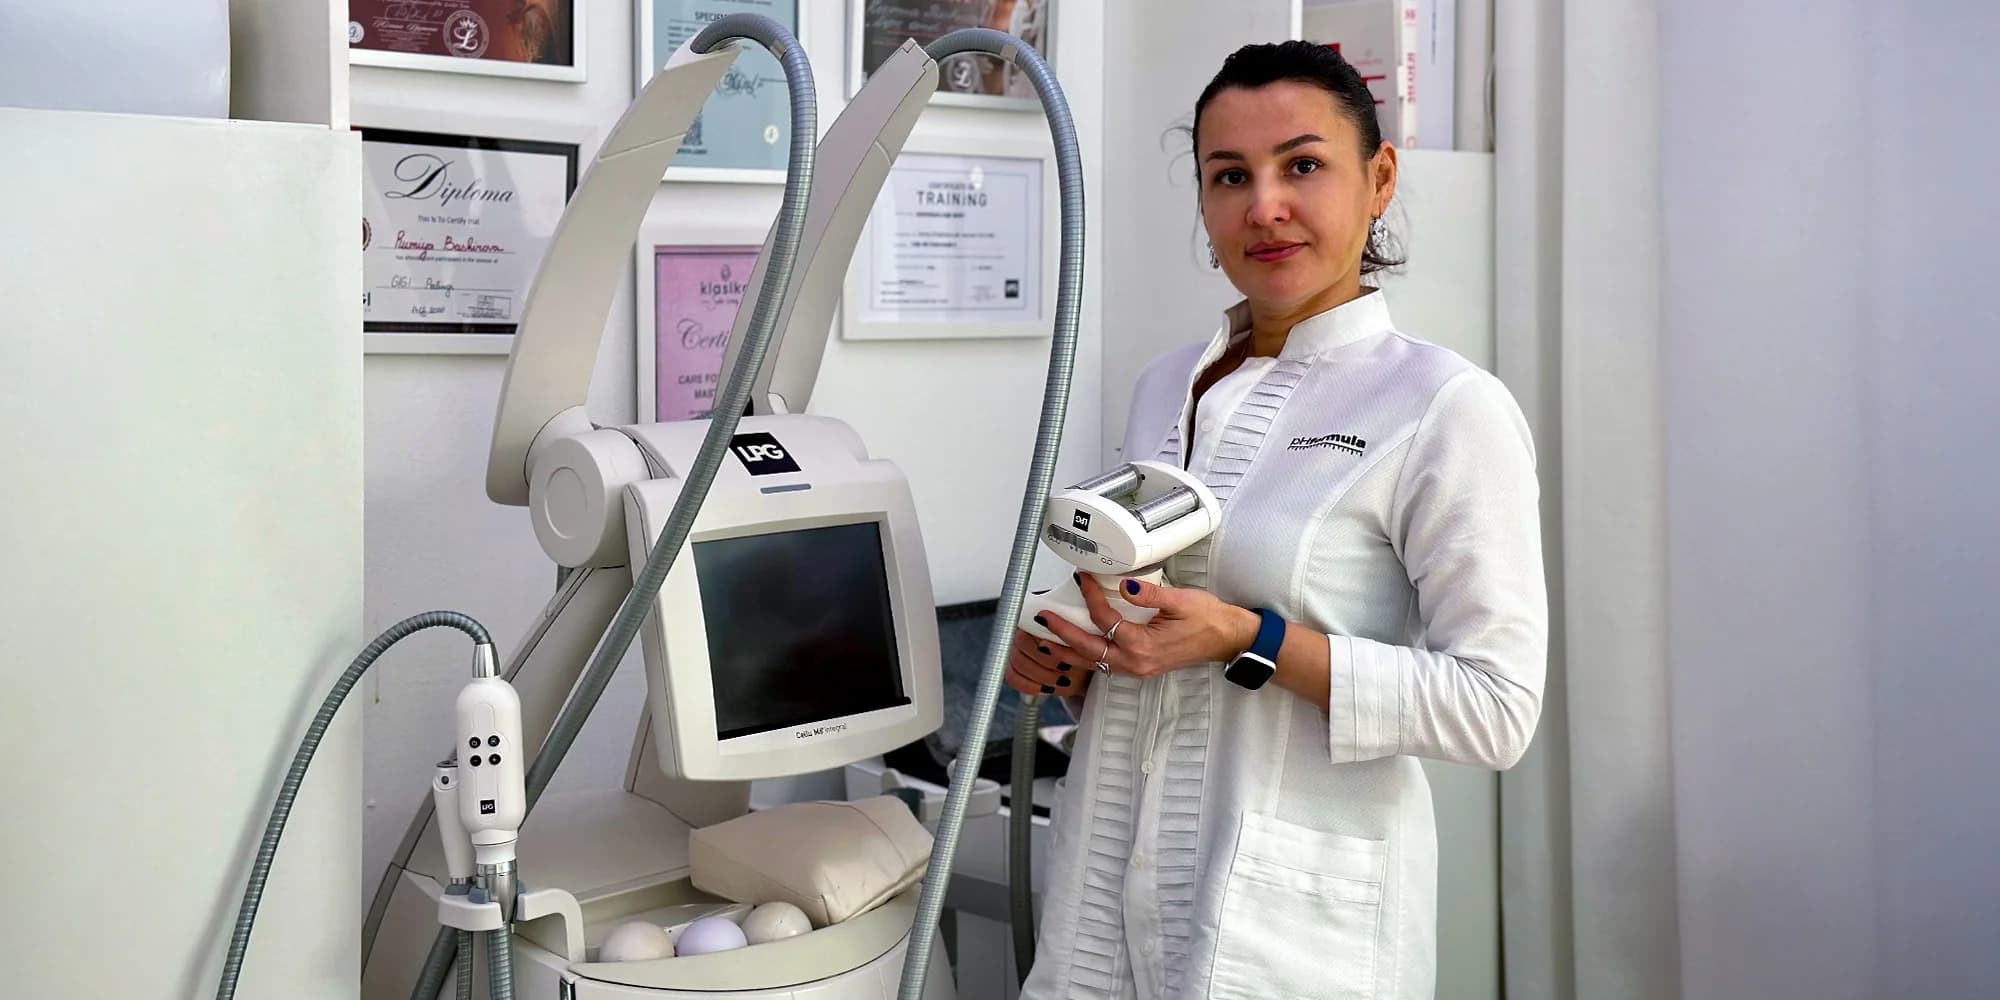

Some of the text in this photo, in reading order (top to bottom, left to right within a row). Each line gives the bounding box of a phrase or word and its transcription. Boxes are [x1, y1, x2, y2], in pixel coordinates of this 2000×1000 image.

[384, 153, 513, 207] Diploma
[917, 191, 988, 207] TRAINING
[676, 318, 730, 350] Certi
[678, 374, 702, 385] CARE
[737, 443, 785, 462] LPG
[1075, 515, 1088, 526] LPG
[481, 803, 494, 811] LPG
